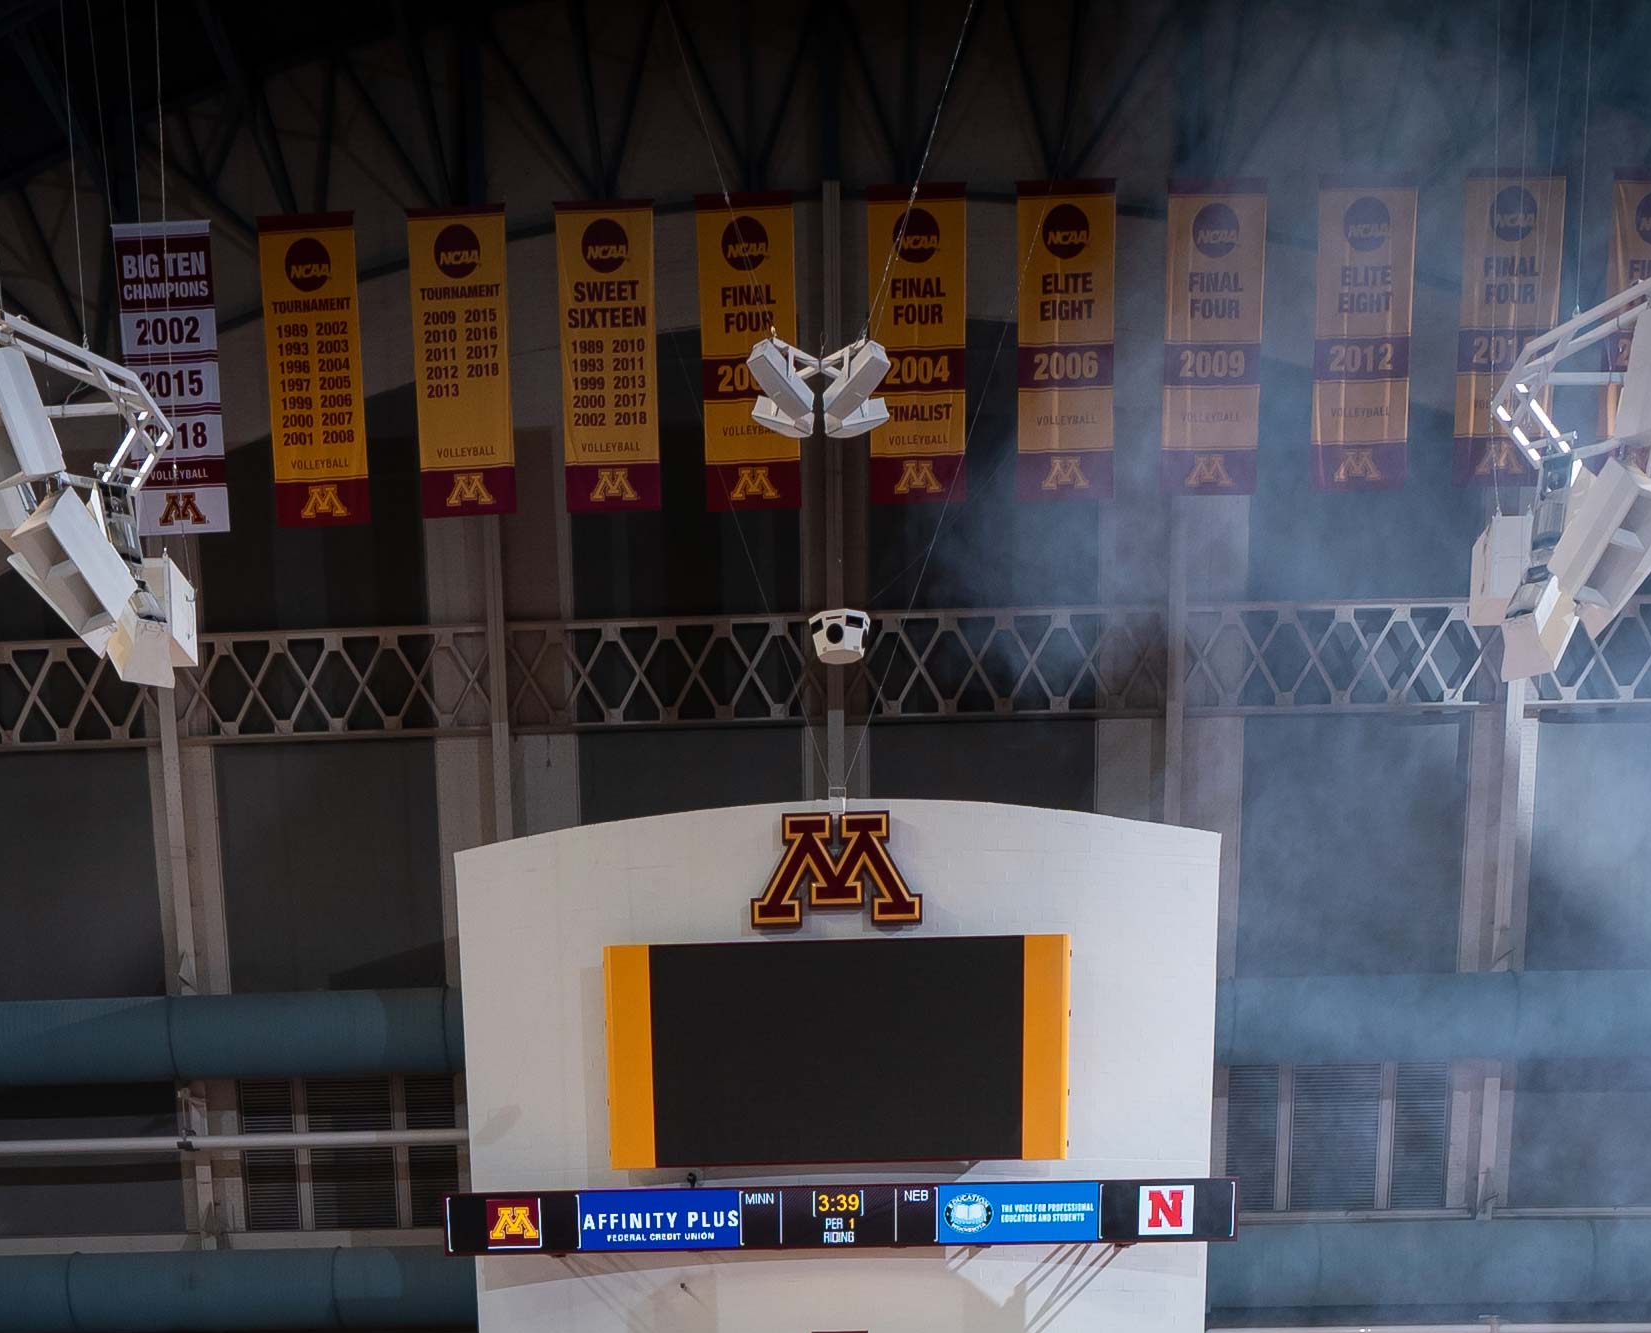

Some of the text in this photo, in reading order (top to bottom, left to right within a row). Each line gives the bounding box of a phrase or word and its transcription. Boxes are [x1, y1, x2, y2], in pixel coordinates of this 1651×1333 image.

[439, 250, 480, 265] NCAA
[586, 245, 629, 260] NCAA
[122, 251, 205, 279] BIG TEN
[291, 263, 331, 280] NCAA
[1484, 256, 1540, 277] FINAL
[1042, 272, 1093, 295] ELITE
[1188, 271, 1243, 292] FINAL
[1341, 265, 1392, 287] ELITE
[123, 281, 209, 300] CHAMPIONS
[420, 284, 500, 301] TOURNAMENT
[574, 280, 639, 302] SWEET
[721, 284, 776, 307] FINAL
[891, 277, 946, 299] FINAL
[1485, 283, 1535, 304] FOUR
[273, 297, 351, 314] TOURNAMENT
[1039, 299, 1095, 321] EIGHT
[1190, 298, 1240, 319] FOUR
[1338, 292, 1393, 313] EIGHT
[423, 309, 497, 326] 2009 2015
[568, 306, 646, 328] SIXTEEN
[724, 310, 774, 333] FOUR
[893, 303, 943, 325] FOUR
[136, 317, 200, 346] 2002
[276, 321, 348, 338] 1989 2002
[424, 327, 498, 344] 2010 2016
[278, 340, 349, 356] 1993 2003
[425, 345, 498, 362] 2011 2017
[572, 338, 645, 354] 1989 2010
[279, 358, 349, 374] 1996 2004
[572, 357, 644, 373] 1993 2011
[1033, 351, 1098, 380] 2006
[1180, 350, 1245, 378] 2009
[1329, 343, 1393, 372] 2012
[426, 363, 499, 381] 2012 2018
[885, 356, 950, 384] 2004
[142, 370, 203, 398] 2015
[280, 376, 351, 392] 1997 2005
[427, 384, 459, 399] 2013
[573, 375, 646, 391] 1999 2013
[281, 394, 352, 410] 1999 2006
[574, 393, 646, 409] 2000 2017
[282, 412, 353, 428] 2000 2007
[574, 412, 647, 427] 2002 2018
[888, 403, 952, 422] FINALIST
[283, 430, 354, 446] 2001 2008
[889, 434, 948, 447] VOLLEYBALL
[437, 445, 495, 459] VOLLEYBALL
[581, 441, 641, 454] VOLLEYBALL
[291, 457, 349, 470] VOLLEYBALL
[151, 468, 208, 481] VOLLEYBALL
[750, 810, 923, 928] M
[745, 1193, 775, 1206] MINN
[818, 1194, 860, 1212] 3:39
[904, 1190, 929, 1201] NEB
[1001, 1204, 1014, 1213] THE
[1034, 1203, 1047, 1212] FOR
[1048, 1203, 1094, 1212] PROFESSIONAL
[1148, 1190, 1184, 1227] N
[490, 1207, 539, 1240] M
[583, 1210, 739, 1231] AFFINITY PLUS
[825, 1217, 855, 1230] PER 1
[1001, 1213, 1085, 1223] EDUCATORS AND STUDENTS
[606, 1231, 715, 1242] FEDERAL CREDIT UNION
[824, 1231, 855, 1243] RIDING
